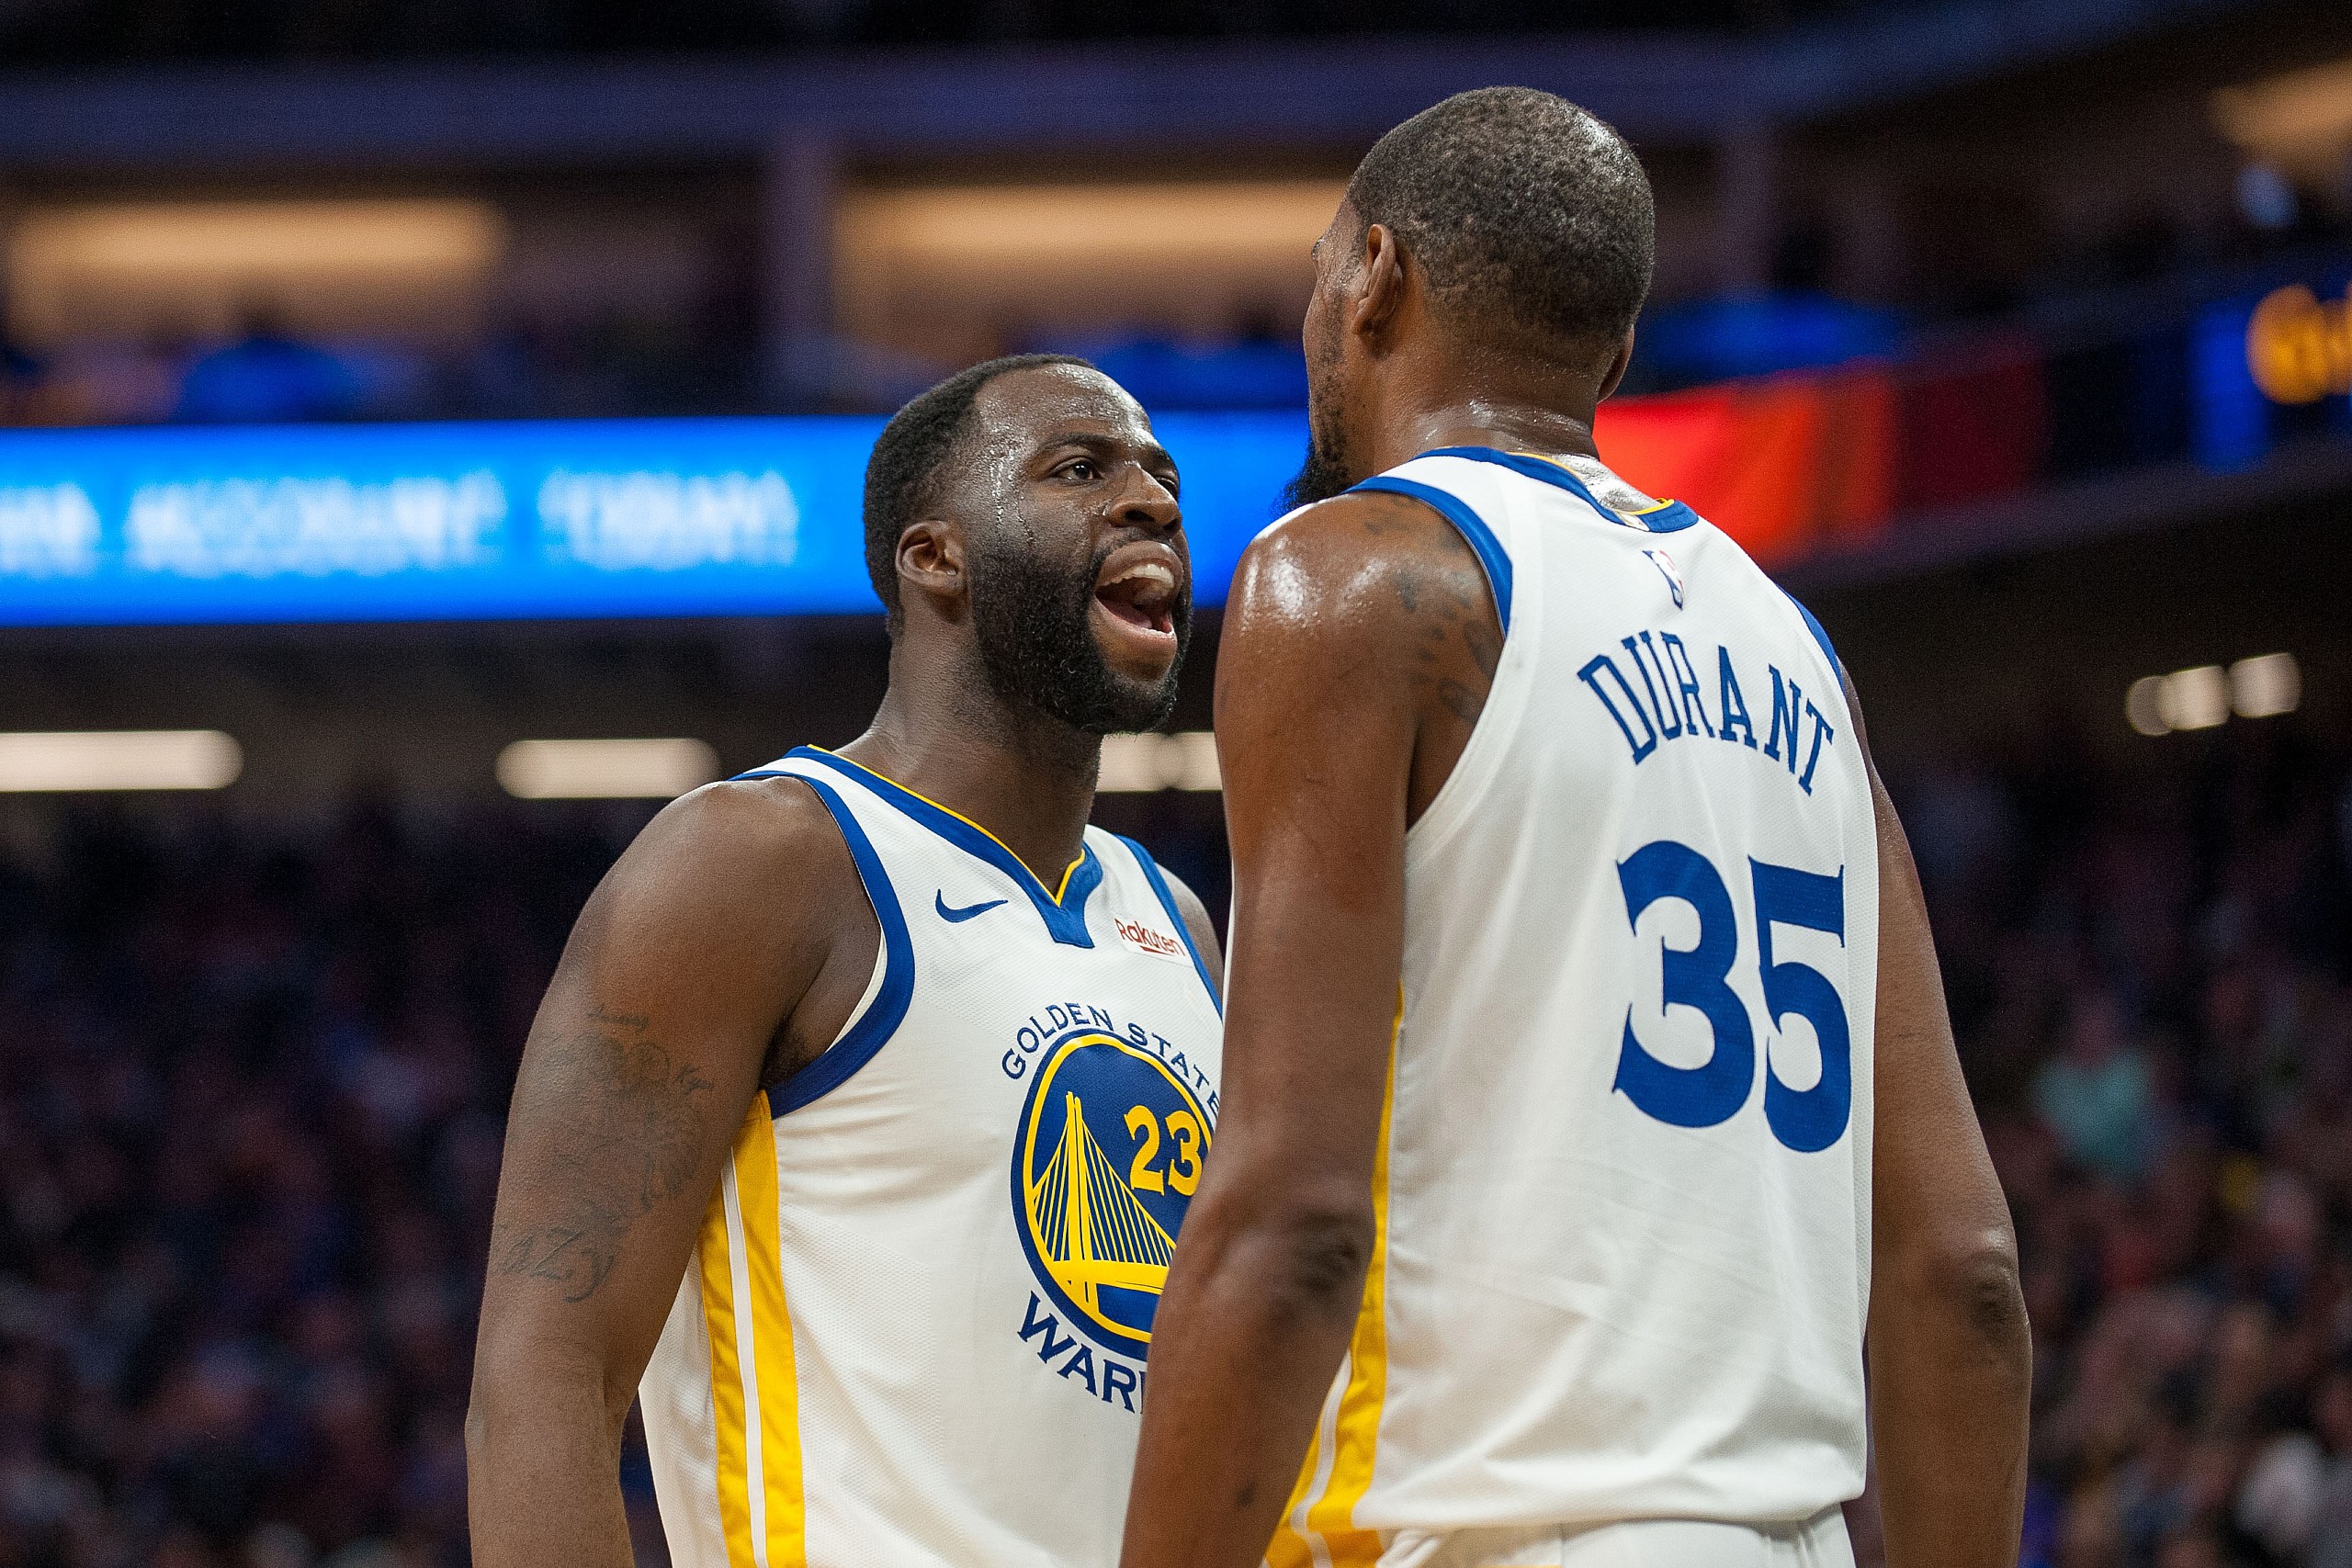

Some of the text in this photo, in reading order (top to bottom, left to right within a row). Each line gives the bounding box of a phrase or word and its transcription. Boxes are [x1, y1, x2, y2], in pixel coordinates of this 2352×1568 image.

[1577, 630, 1834, 796] DURANT
[1114, 919, 1186, 956] Rakuten
[1611, 840, 1852, 1153] 35
[1001, 1002, 1221, 1121] GOLDEN STATE
[1123, 1104, 1203, 1197] 23
[1017, 1290, 1148, 1415] WAR
